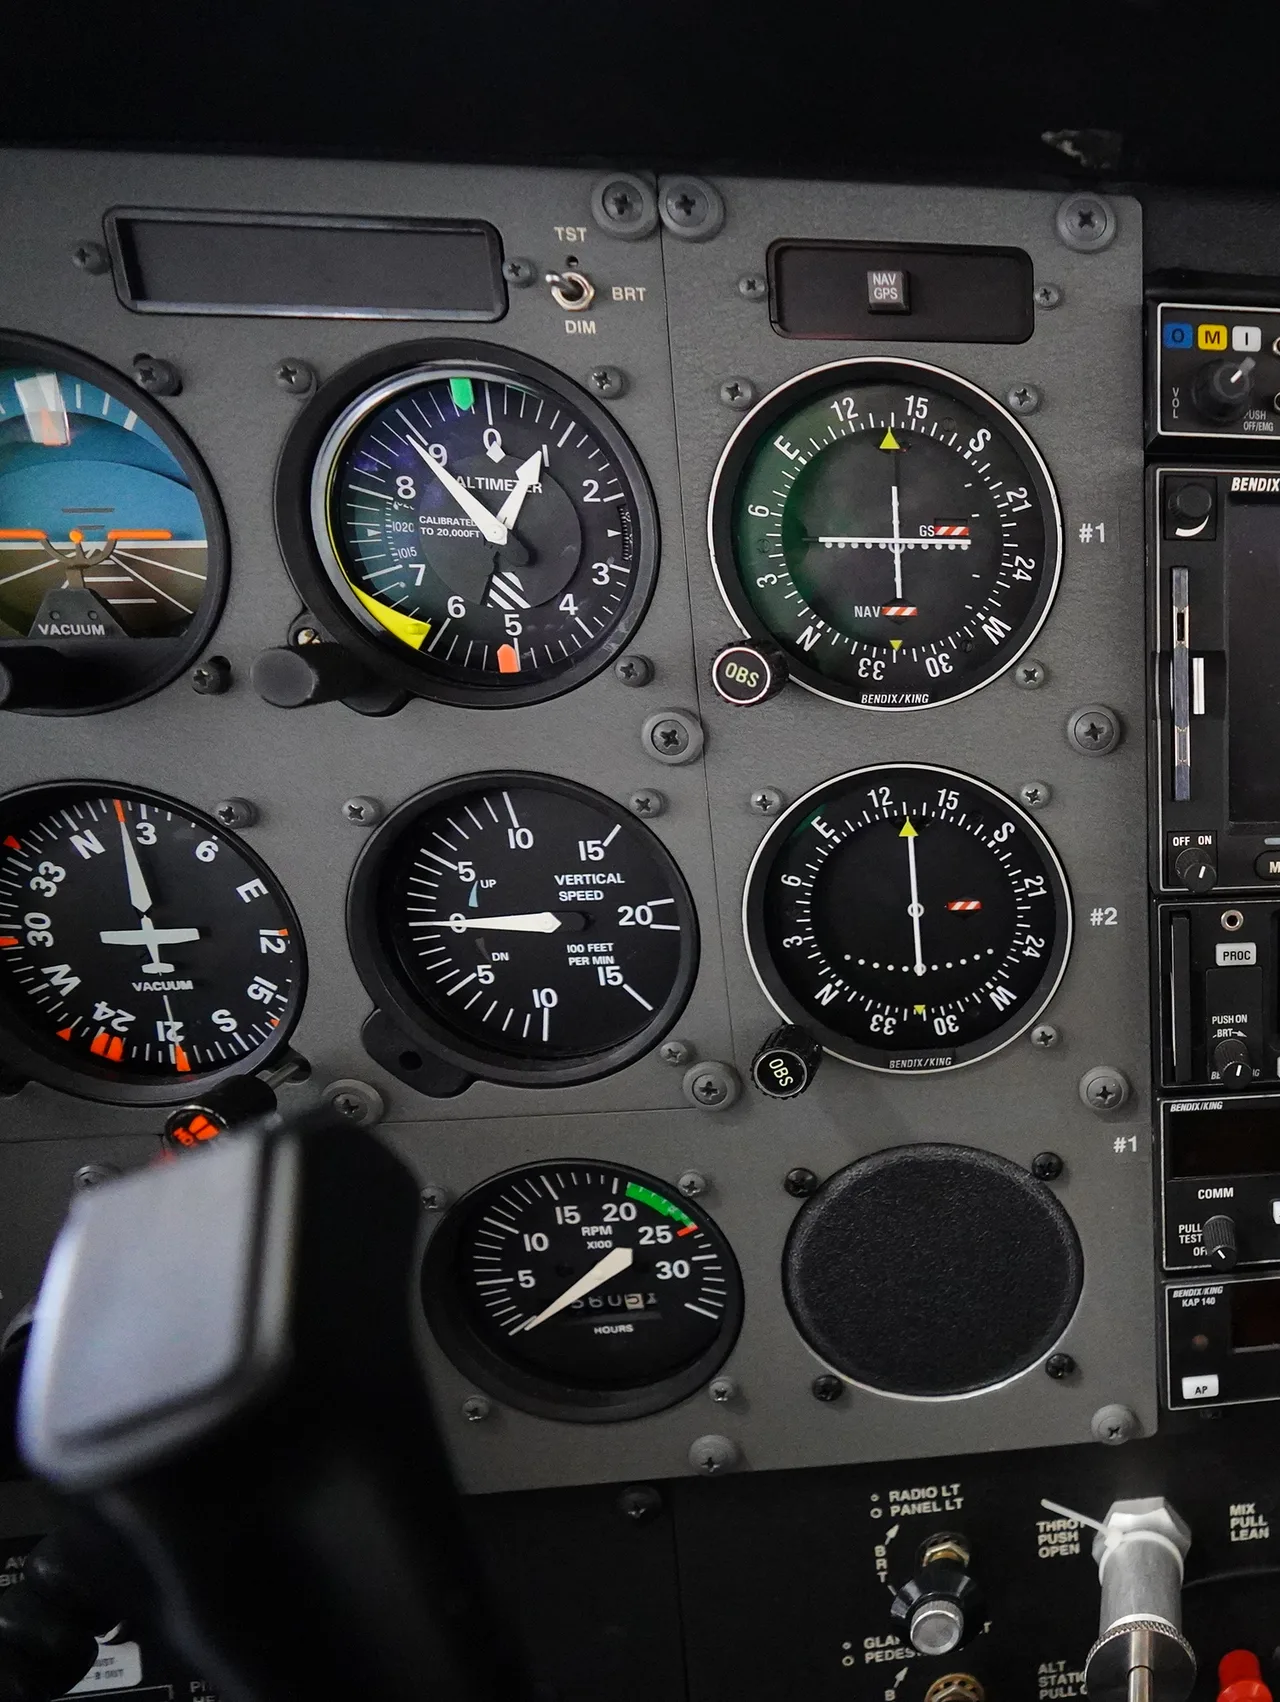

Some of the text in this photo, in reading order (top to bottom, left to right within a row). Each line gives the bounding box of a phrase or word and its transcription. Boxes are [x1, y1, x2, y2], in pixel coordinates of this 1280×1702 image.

[554, 227, 587, 241] TST
[872, 273, 896, 286] NAV
[611, 287, 646, 301] BRT
[873, 287, 898, 300] GPS
[565, 319, 596, 335] DIM
[1204, 330, 1221, 345] M
[830, 396, 859, 422] 12
[905, 394, 928, 419] 15
[395, 476, 416, 500] 8
[582, 479, 601, 503] 2
[392, 521, 415, 532] 1020
[919, 525, 934, 537] GS
[1079, 523, 1107, 543] #1
[408, 563, 426, 586] 7
[592, 562, 610, 585] 3
[447, 596, 466, 618] 6
[559, 593, 578, 615] 4
[854, 605, 880, 618] NAV
[37, 623, 105, 637] VACUUM
[504, 613, 522, 636] 5
[725, 662, 760, 688] OBS
[861, 693, 929, 704] BENDIX/KING
[866, 786, 893, 808] 12
[937, 789, 961, 812] 15
[136, 822, 158, 845] 3
[508, 827, 534, 849] 10
[1173, 835, 1212, 847] OFF ON
[69, 829, 105, 859] N
[578, 840, 604, 861] 15
[458, 861, 476, 882] 5
[554, 873, 625, 885] VERTICAL
[481, 879, 497, 888] UP
[559, 890, 604, 902] SPEED
[618, 905, 653, 926] 20
[1090, 907, 1118, 926] #2
[567, 943, 614, 953] 100 FEET
[492, 952, 509, 961] DN
[569, 956, 614, 966] PER MIN
[1223, 951, 1251, 961] PROC
[477, 964, 495, 984] 5
[597, 965, 623, 986] 15
[132, 980, 194, 992] VACUUM
[533, 988, 558, 1009] 10
[1212, 1014, 1247, 1025] PUSH ON
[1217, 1028, 1232, 1038] BRT
[889, 1057, 952, 1069] BENDIX/KING
[768, 1058, 793, 1088] OBS
[1170, 1101, 1223, 1112] BENDIX/KING
[1113, 1136, 1137, 1153] #1
[1198, 1187, 1234, 1200] COMM
[555, 1206, 581, 1224] 15
[602, 1202, 637, 1222] 20
[582, 1226, 612, 1236] RPM
[638, 1225, 673, 1244] 25
[524, 1232, 549, 1252] 10
[587, 1240, 612, 1248] X100
[656, 1260, 690, 1280] 30
[518, 1270, 535, 1288] 5
[1182, 1297, 1216, 1307] KAP 140
[594, 1324, 634, 1334] HOURS
[1195, 1386, 1208, 1395] AP
[888, 1484, 960, 1503] RADIO LT
[890, 1498, 964, 1517] PANEL LT
[1230, 1503, 1256, 1516] MIX
[1230, 1516, 1268, 1528] PULL
[1038, 1532, 1079, 1546] PUSH
[1230, 1527, 1270, 1542] LEAN
[1038, 1544, 1080, 1559] OPEN
[1038, 1661, 1066, 1674] ALT
